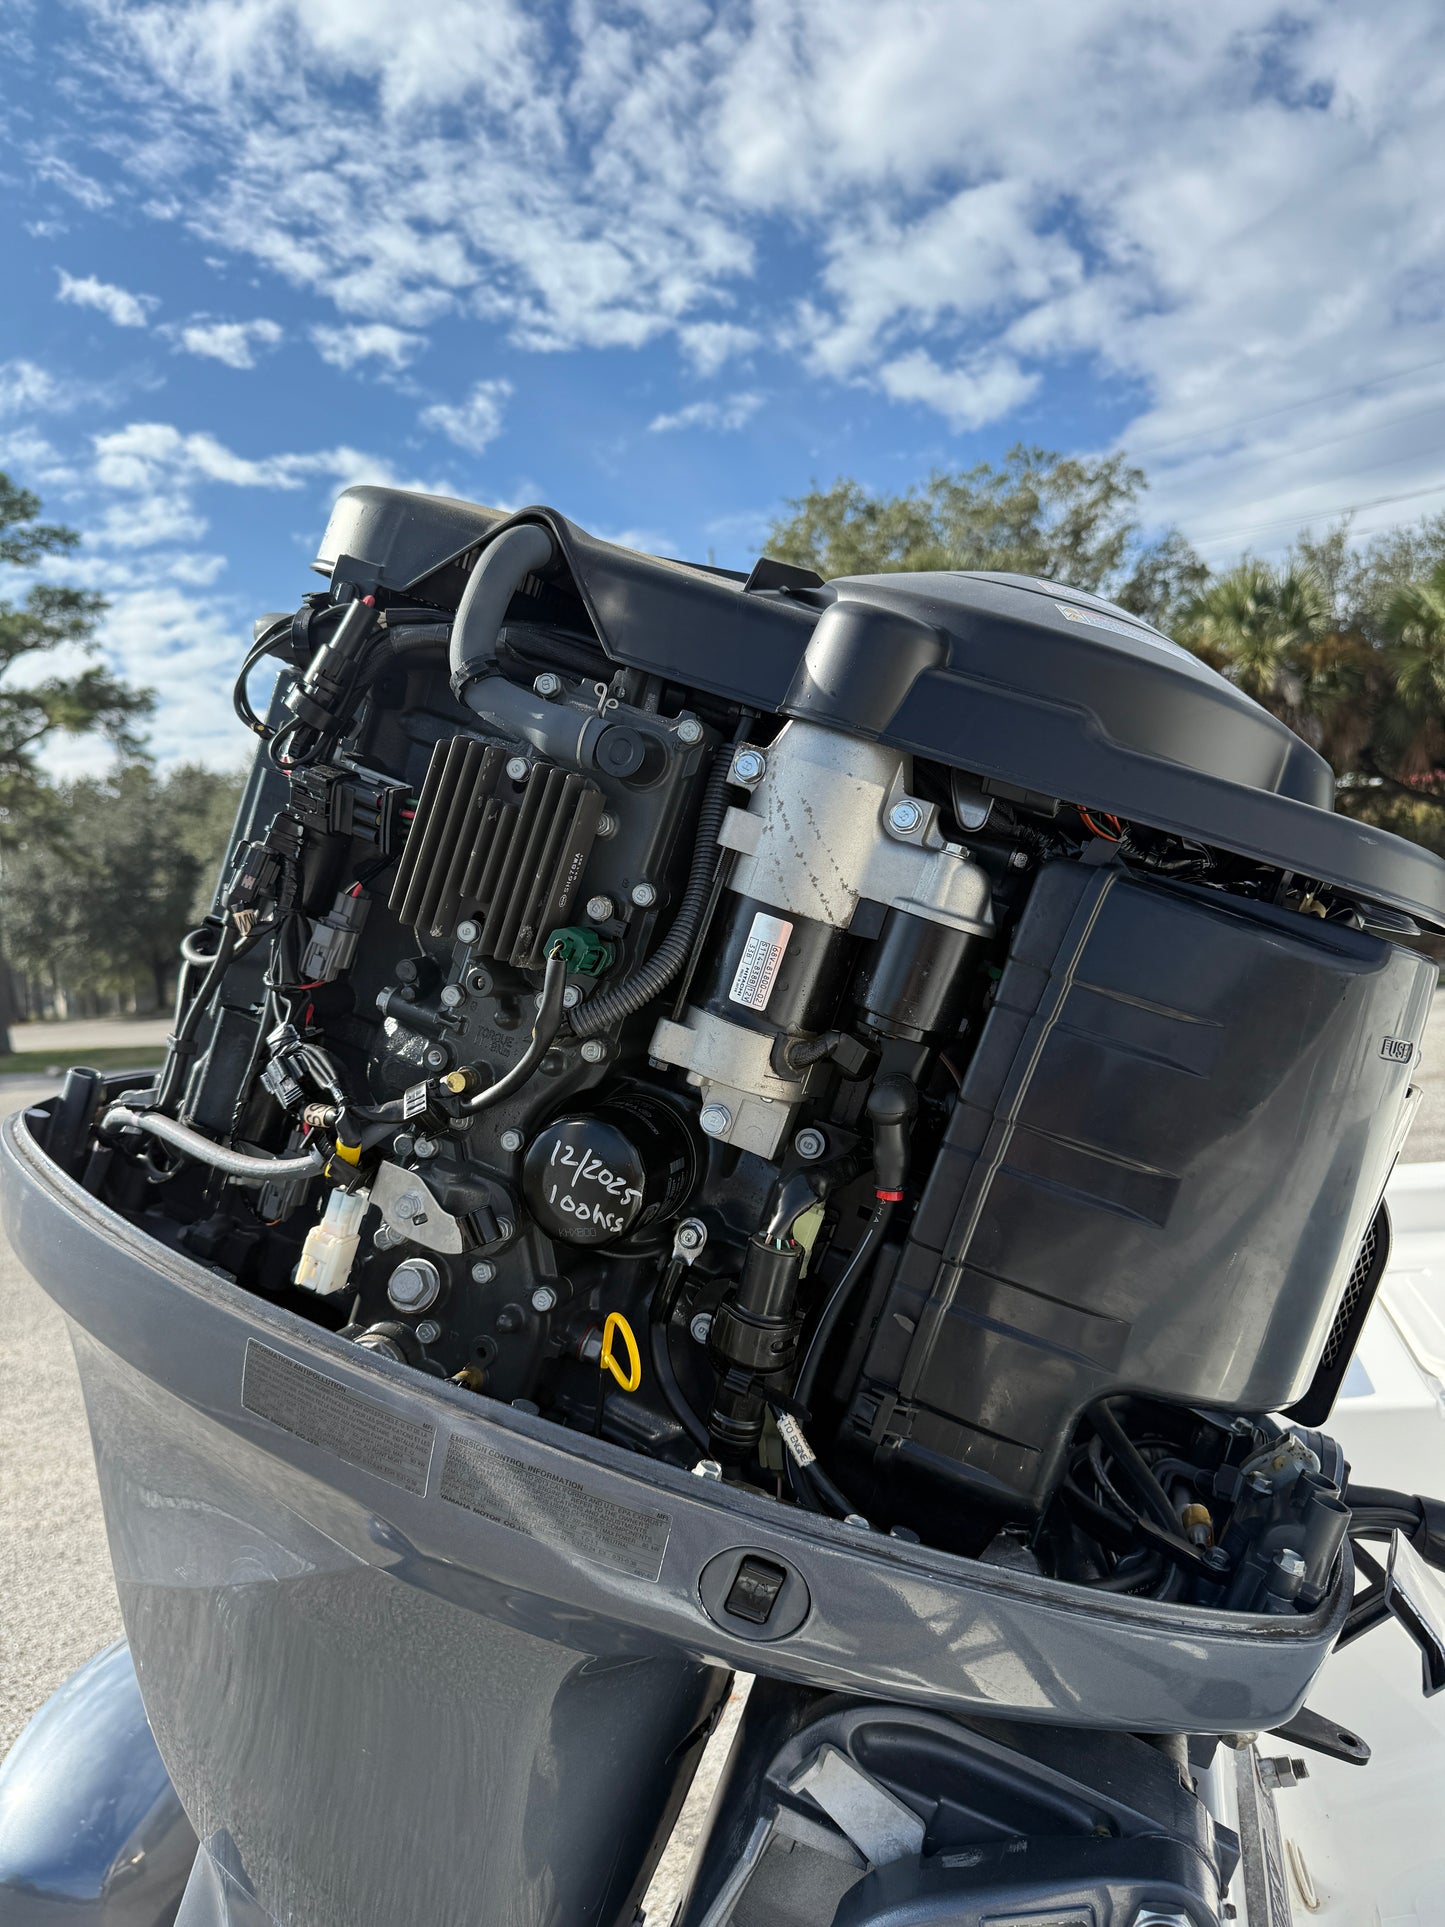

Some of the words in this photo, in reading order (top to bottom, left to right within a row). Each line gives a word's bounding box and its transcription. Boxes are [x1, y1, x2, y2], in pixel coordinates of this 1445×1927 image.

[735, 966, 750, 997] HITACHI
[754, 946, 780, 1004] 68V-81800-02
[551, 1139, 643, 1205] 12/2025
[293, 1362, 346, 1393] ANTIPOLLUTION
[784, 1420, 794, 1433] TO
[790, 1435, 809, 1462] ENGINE
[449, 1432, 487, 1454] EMISSION
[488, 1448, 527, 1469] CONTROL
[527, 1463, 584, 1491] INFORMATION
[439, 1492, 471, 1510] YAMAHA
[472, 1506, 501, 1523] MOTOR
[655, 1511, 669, 1521] MFI
